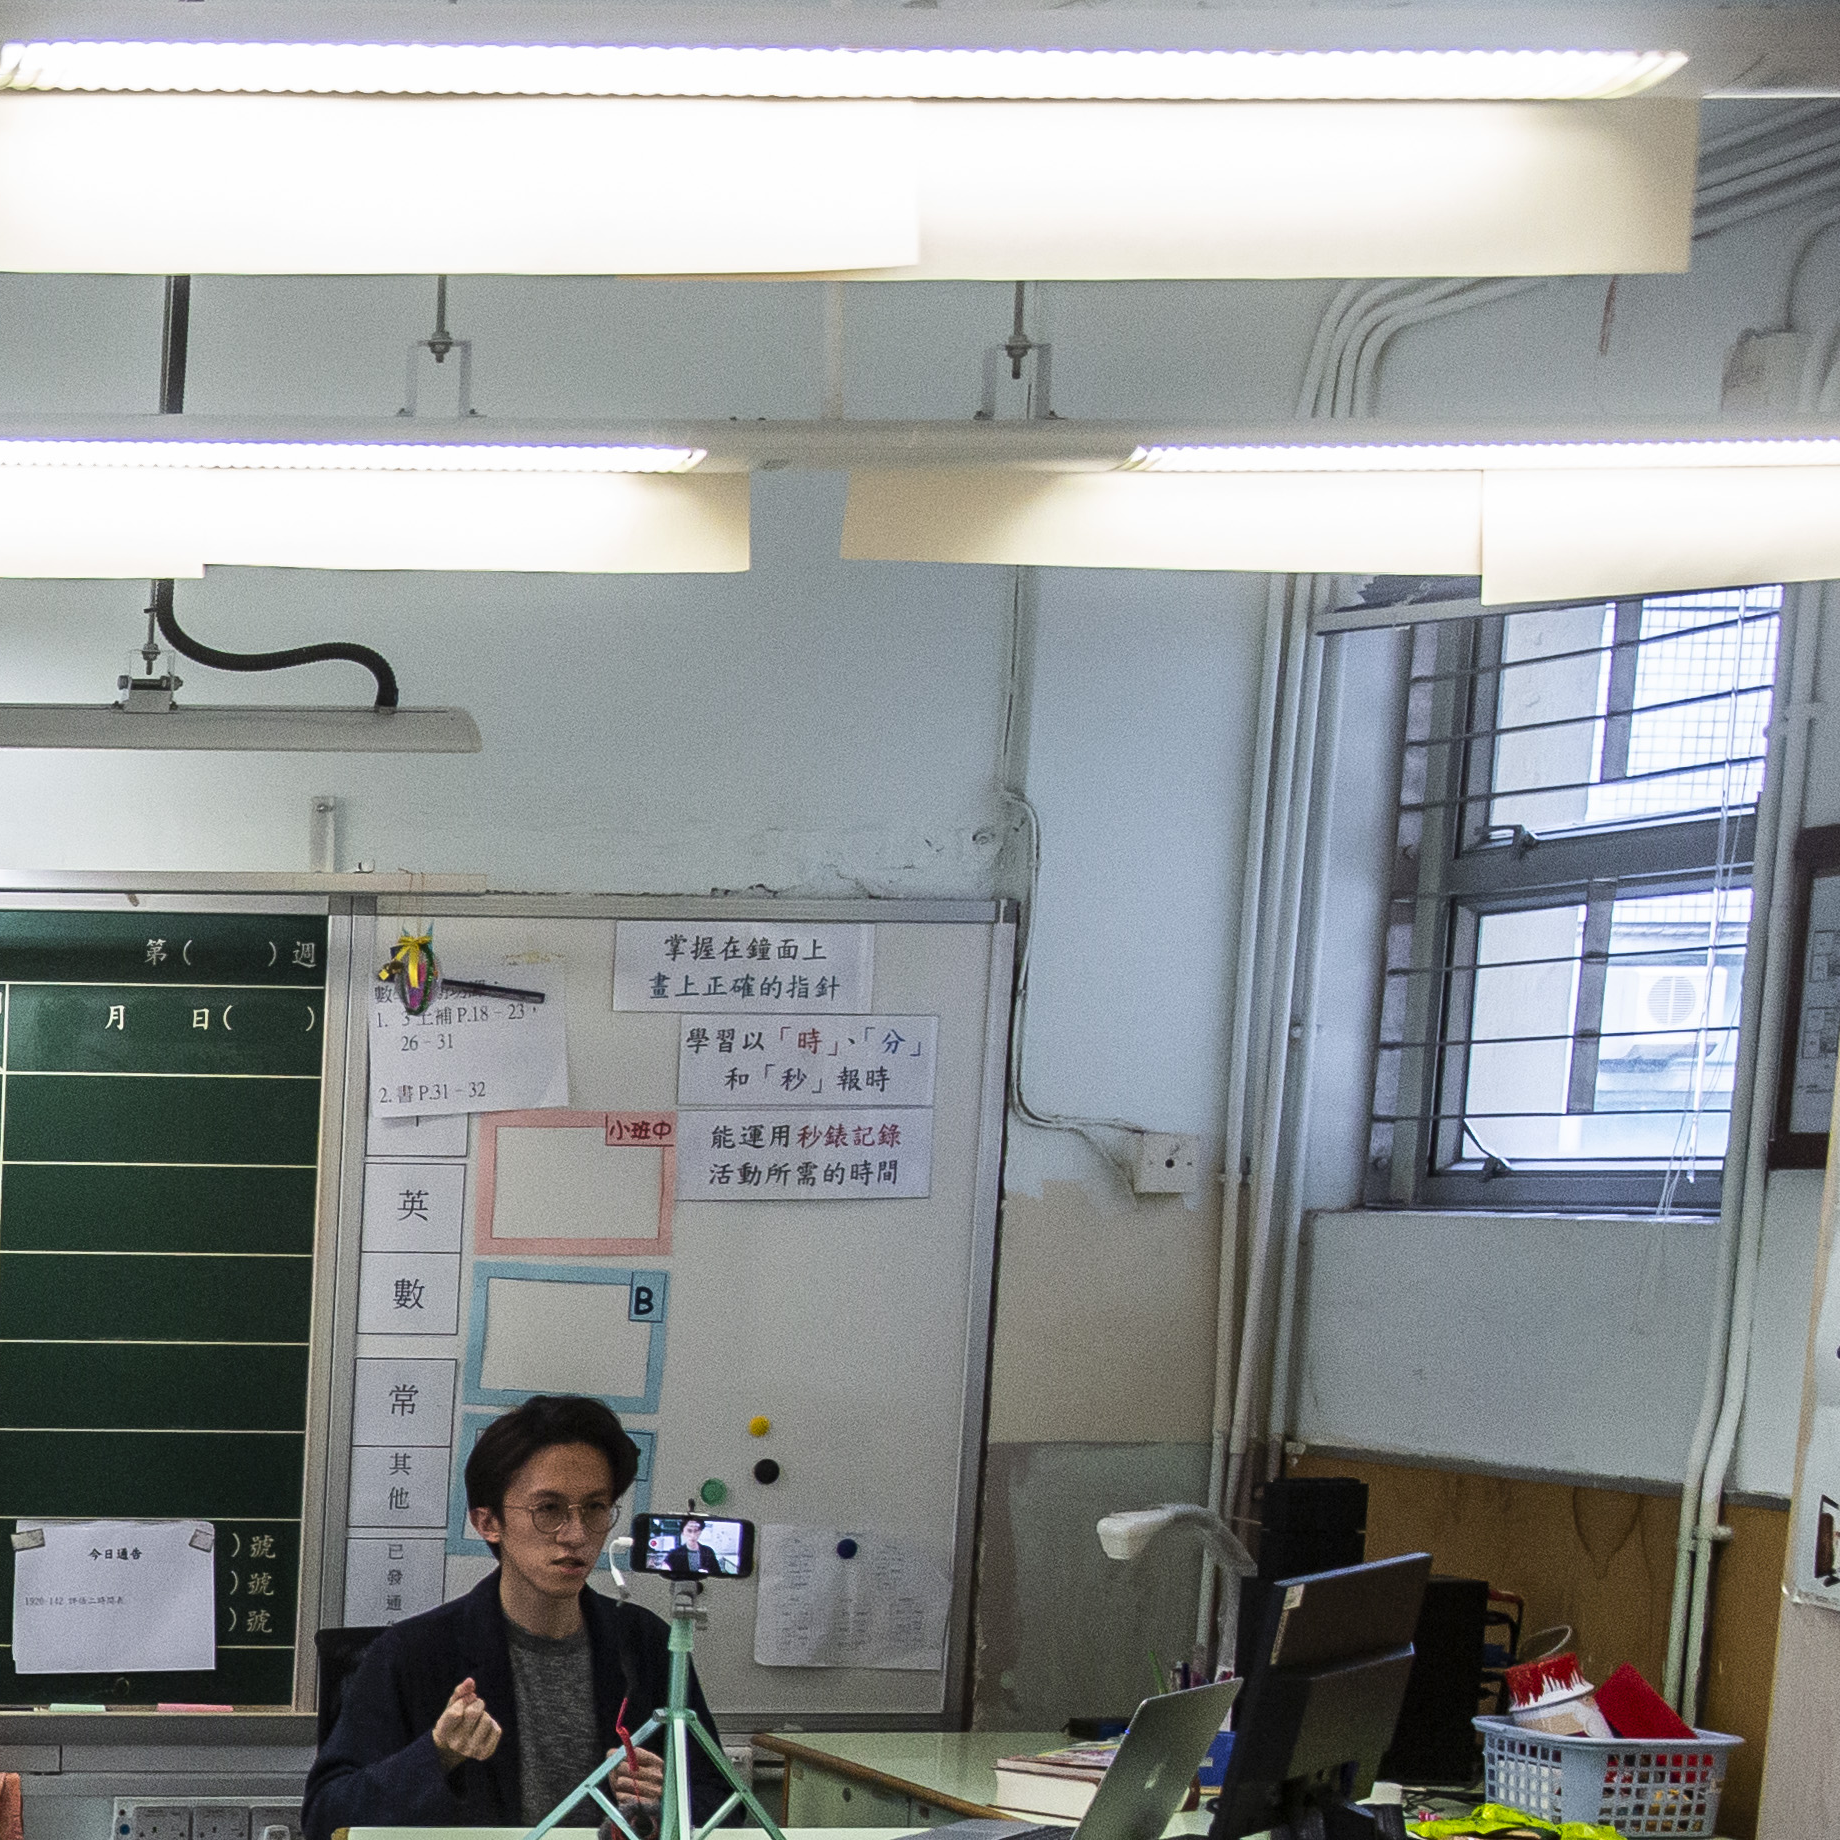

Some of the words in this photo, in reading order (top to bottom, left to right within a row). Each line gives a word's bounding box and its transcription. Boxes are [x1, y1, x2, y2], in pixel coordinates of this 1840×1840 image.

[663, 934, 827, 962] 掌握在鐘面上
[649, 971, 841, 1000] 畫上正確的指針
[106, 1005, 125, 1031] 月
[457, 1005, 489, 1023] P.18
[401, 1035, 419, 1051] 26
[437, 1033, 454, 1050] 31
[379, 1087, 392, 1103] 2.
[419, 1083, 449, 1101] P.31
[468, 1081, 486, 1097] 32
[609, 1120, 672, 1140] 小班中
[711, 1123, 902, 1150] 能運用秒錶記錄
[709, 1159, 899, 1187] 活動所需的時間
[397, 1189, 429, 1222] 英
[393, 1278, 425, 1310] 數
[634, 1286, 654, 1316] B
[389, 1384, 419, 1416] 常
[388, 1452, 412, 1511] 其他
[88, 1548, 142, 1561] 今日通告
[386, 1544, 404, 1626] 已發通
